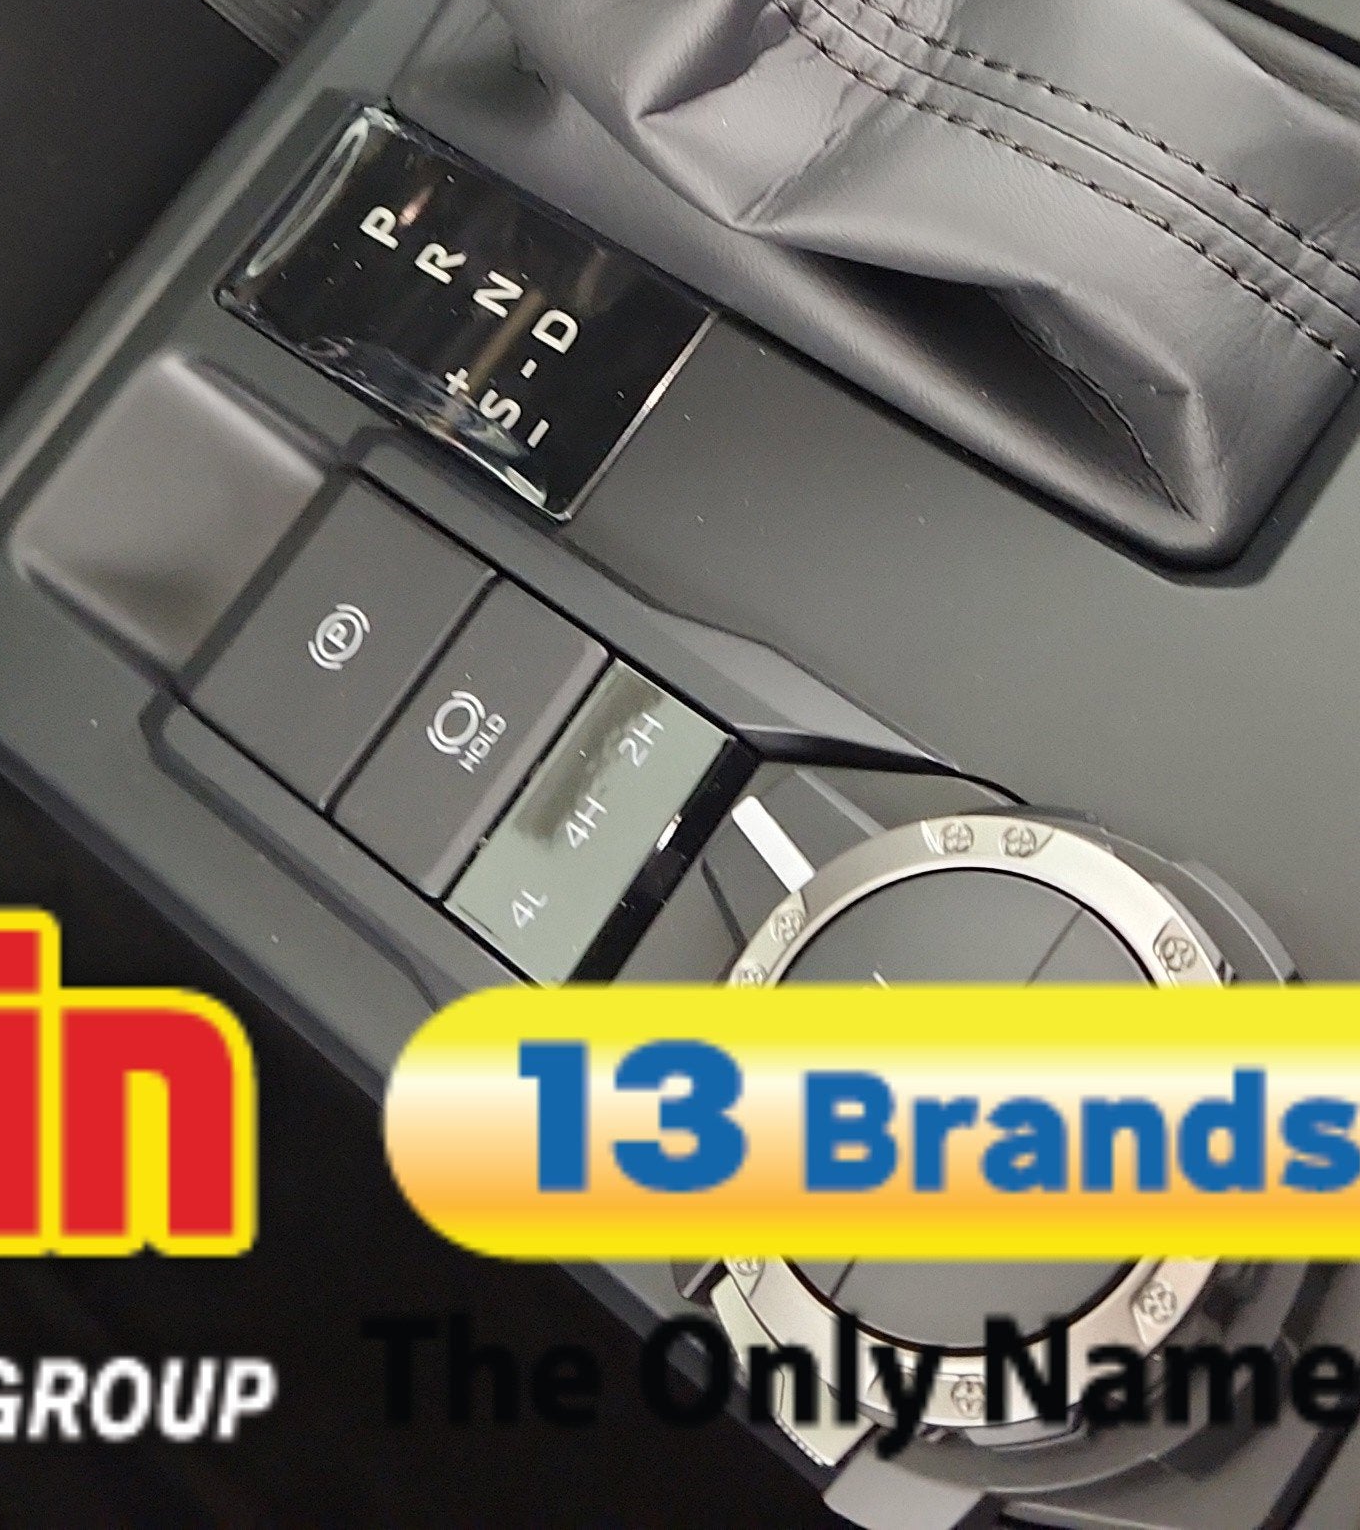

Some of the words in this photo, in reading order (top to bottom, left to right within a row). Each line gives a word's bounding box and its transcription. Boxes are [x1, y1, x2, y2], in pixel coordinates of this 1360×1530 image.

[359, 206, 398, 249] P
[414, 243, 466, 284] R
[473, 271, 524, 318] N
[458, 712, 508, 773] HOLD
[618, 713, 664, 768] 2H
[564, 795, 607, 850] 4H
[509, 890, 549, 930] 4L
